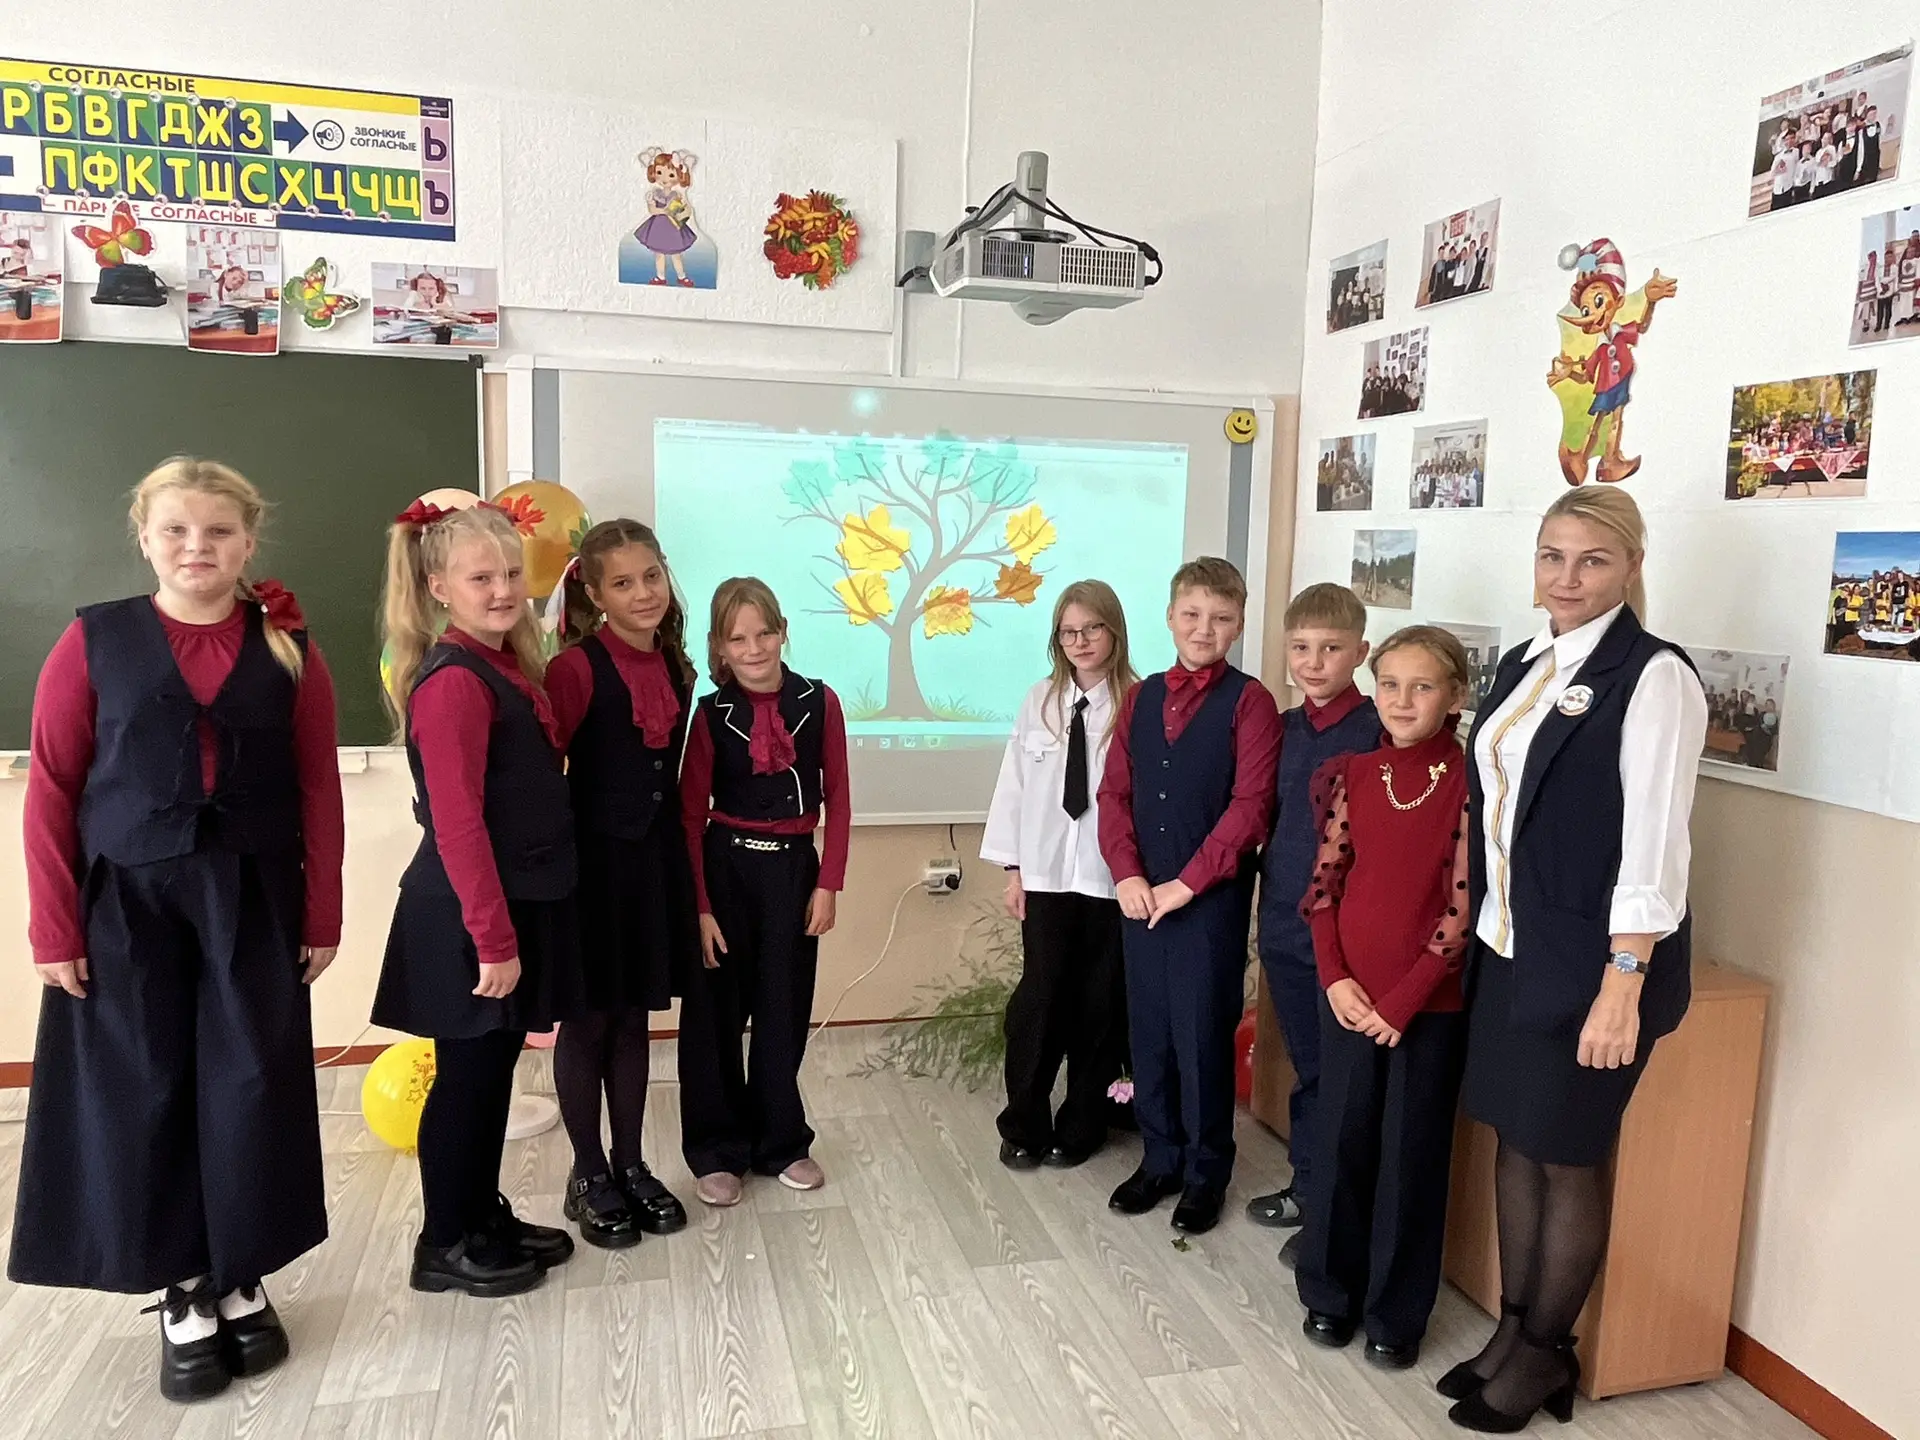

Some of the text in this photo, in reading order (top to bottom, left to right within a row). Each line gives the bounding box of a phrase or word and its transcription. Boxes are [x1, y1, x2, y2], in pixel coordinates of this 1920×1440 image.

[48, 66, 197, 93] СОГЛАСНЫЕ
[3, 88, 264, 149] Р Б В Г Д Ж З
[354, 126, 407, 140] ЗВОНКИЕ
[350, 137, 417, 152] СОГЛАСНЫЕ
[424, 126, 448, 161] Ь
[44, 147, 420, 217] П Ф К Т Ш С Х Ц Ч Щ
[424, 180, 449, 215] Ъ
[150, 205, 257, 224] СОГЛАСНЫЕ
